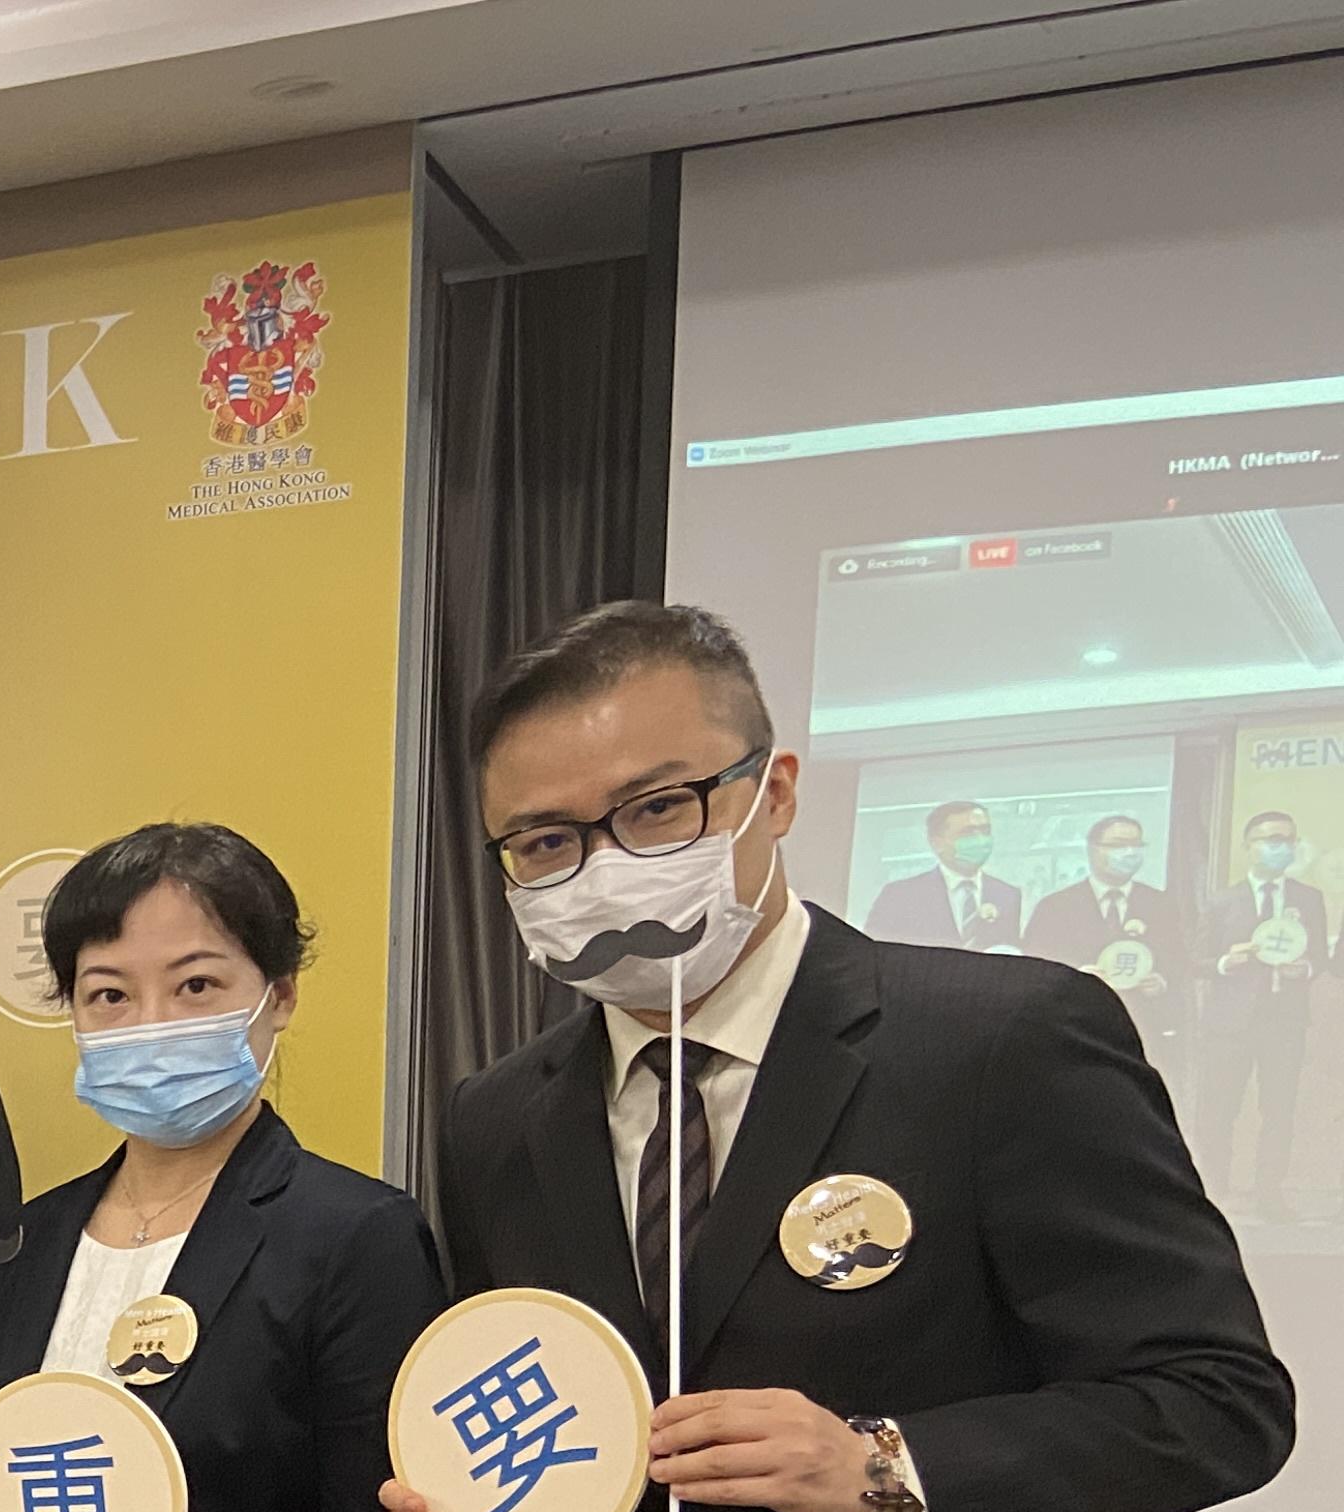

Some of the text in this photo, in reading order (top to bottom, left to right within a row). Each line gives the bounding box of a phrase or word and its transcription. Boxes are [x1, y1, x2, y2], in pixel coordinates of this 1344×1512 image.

[204, 445, 313, 477] 香港醫學會
[1168, 455, 1231, 474] HKMA
[977, 546, 1009, 561] LIVE
[813, 1195, 862, 1226] Matters
